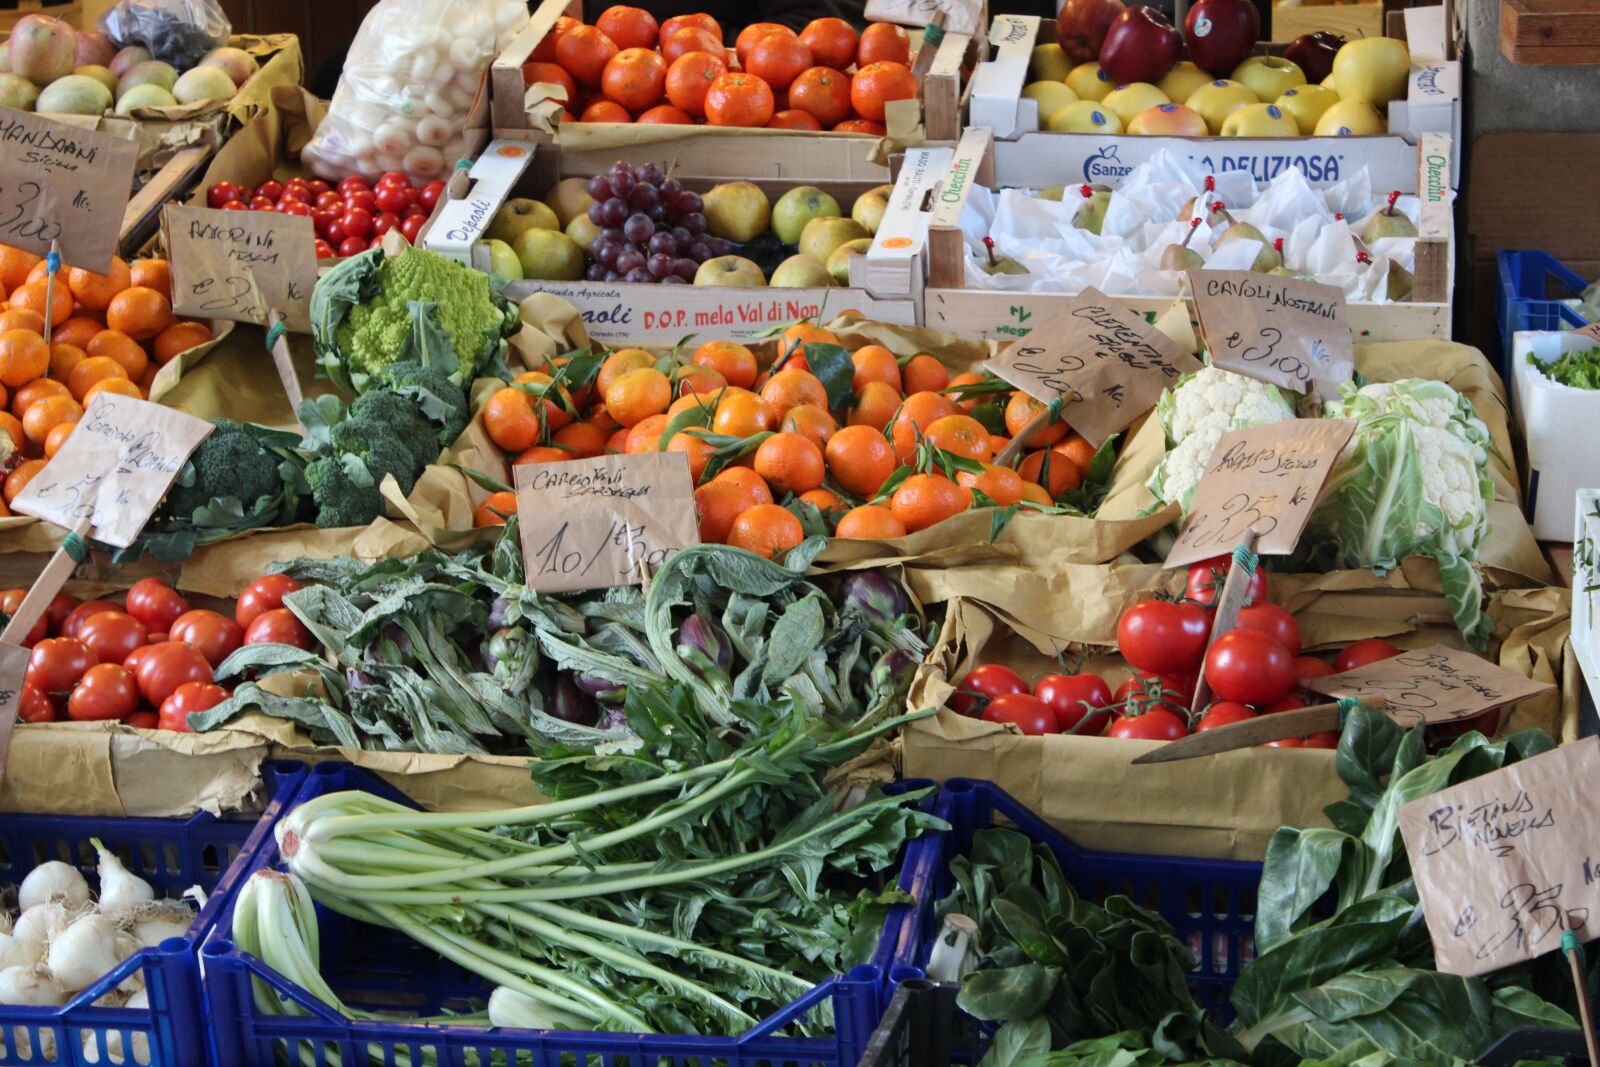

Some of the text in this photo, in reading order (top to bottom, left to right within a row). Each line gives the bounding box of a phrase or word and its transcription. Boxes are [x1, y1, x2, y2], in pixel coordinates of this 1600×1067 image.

[1091, 163, 1136, 176] Sanze
[644, 309, 688, 330] D.O.P.
[695, 304, 734, 327] mela
[737, 301, 763, 323] Val
[767, 301, 783, 322] di
[786, 299, 819, 321] Non
[1207, 278, 1338, 320] CAVOLI NOSTRANI
